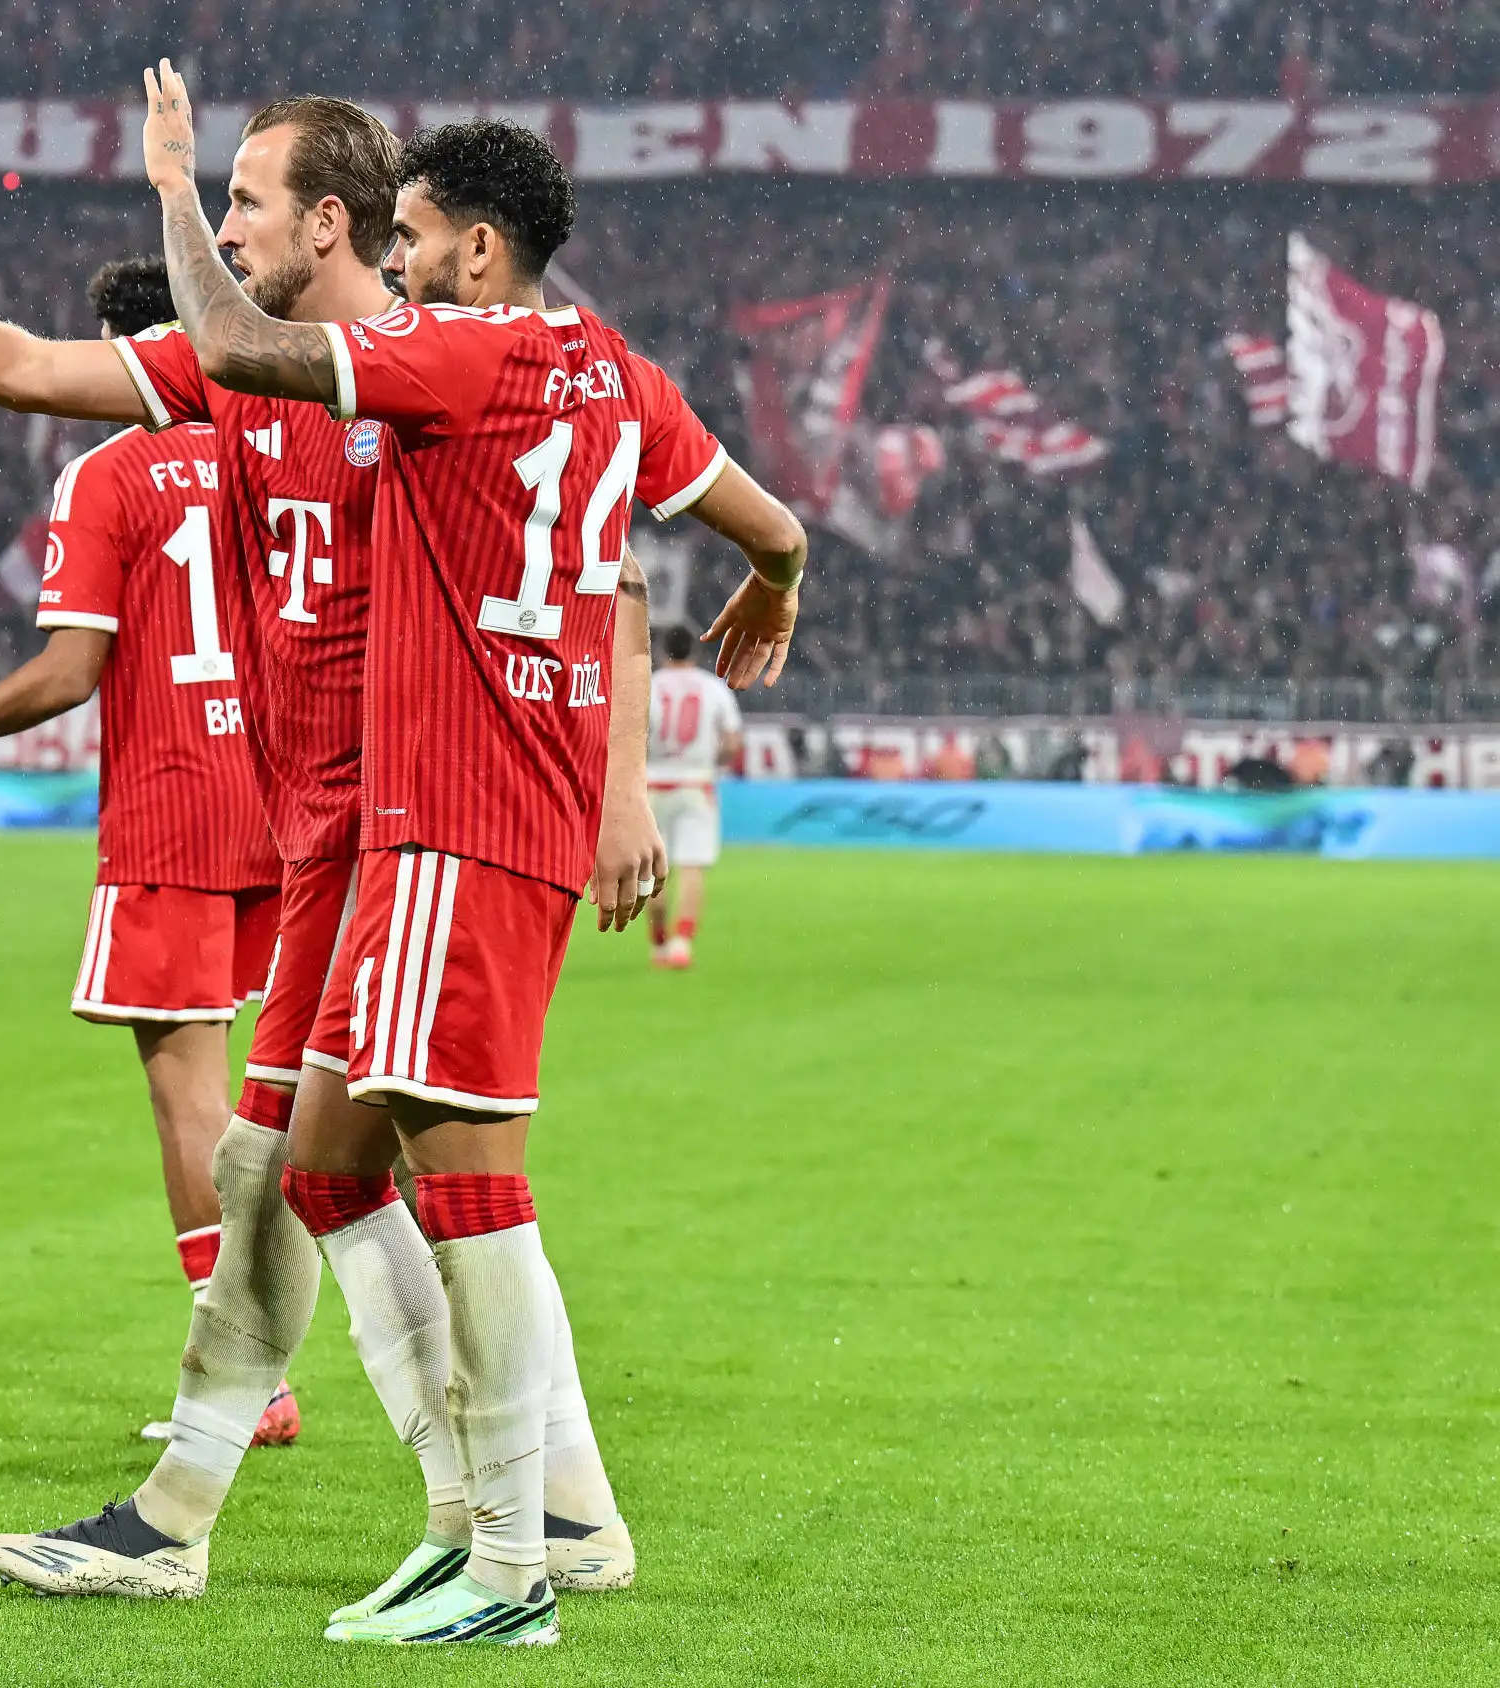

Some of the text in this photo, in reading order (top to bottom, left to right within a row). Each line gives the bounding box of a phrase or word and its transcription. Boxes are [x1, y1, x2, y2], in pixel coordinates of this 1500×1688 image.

[929, 102, 1441, 181] 1972
[149, 460, 191, 492] FC
[476, 420, 642, 640] 14
[485, 651, 563, 702] UIS
[657, 691, 702, 744] 10
